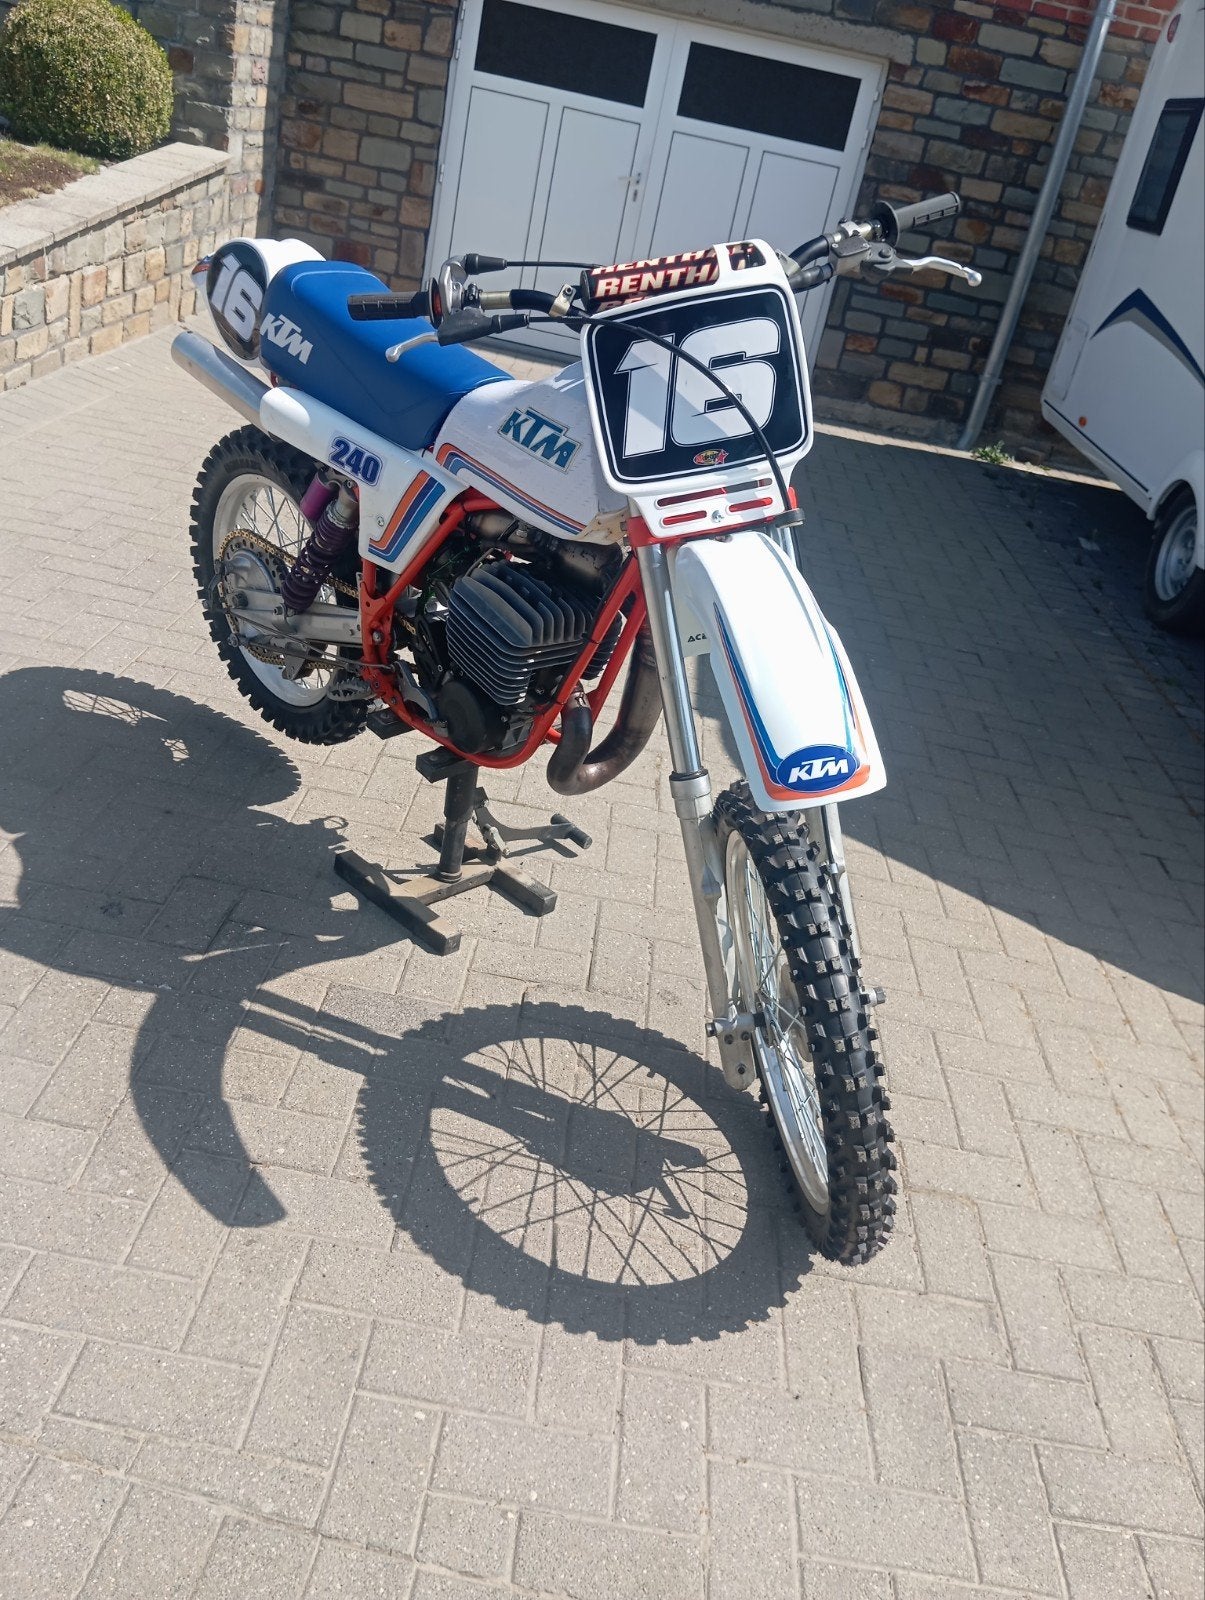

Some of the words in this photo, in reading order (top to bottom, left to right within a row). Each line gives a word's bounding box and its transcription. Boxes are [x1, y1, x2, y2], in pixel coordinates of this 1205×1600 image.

[211, 253, 264, 342] 16
[260, 314, 314, 365] KTM
[614, 317, 781, 459] 16
[329, 436, 383, 485] 240
[500, 409, 577, 468] KTM
[788, 756, 849, 784] KTM
